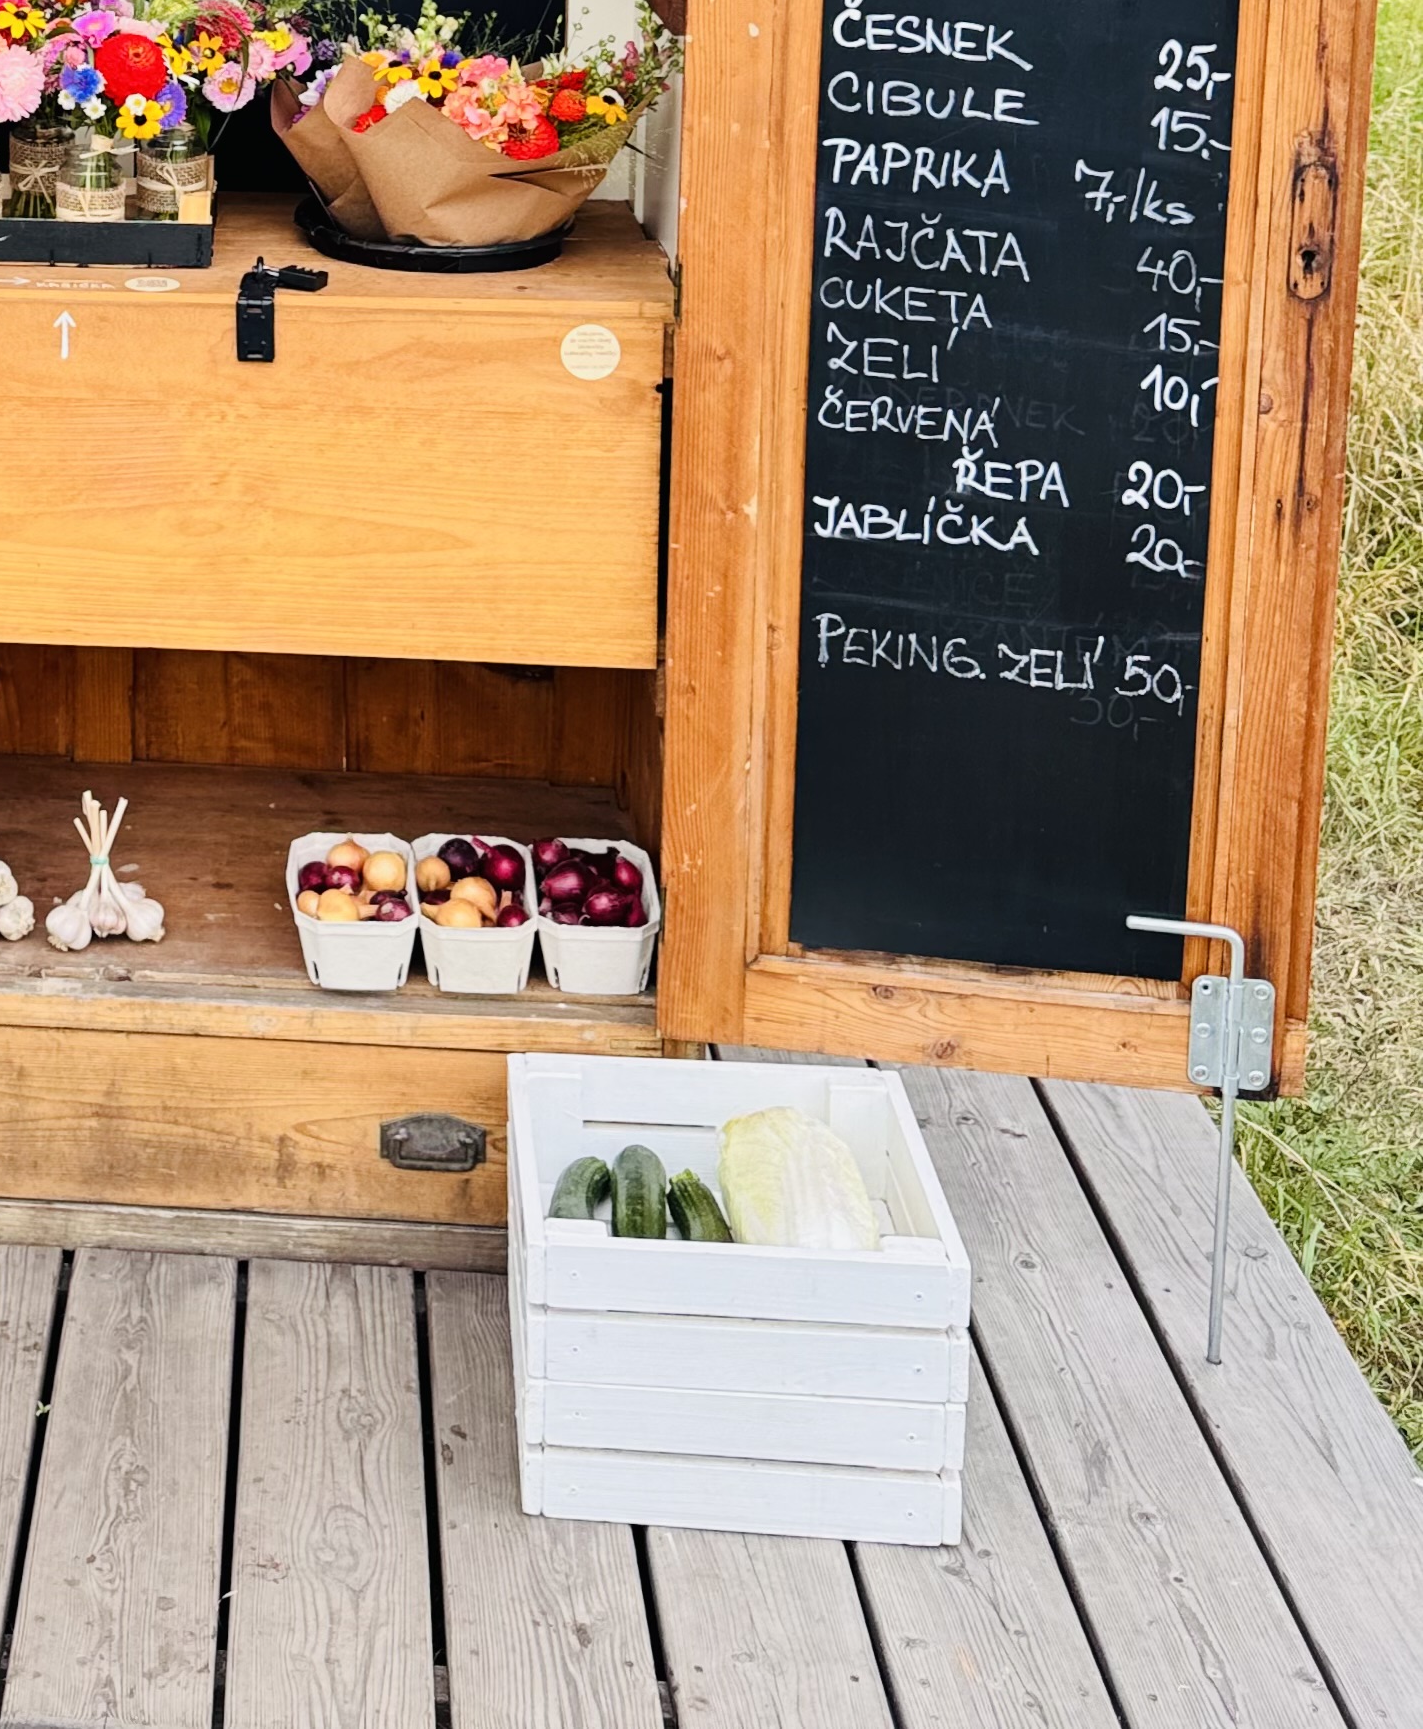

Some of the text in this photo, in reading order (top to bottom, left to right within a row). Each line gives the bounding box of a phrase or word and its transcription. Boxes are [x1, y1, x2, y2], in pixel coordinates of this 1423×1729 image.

[828, 71, 1039, 125] CIBULE
[823, 138, 1009, 197] PAPRIKA
[824, 207, 1029, 282] RAJČATA
[820, 277, 992, 330] CUKETA
[827, 322, 958, 383] ZELÍ
[818, 385, 1000, 448] ČERVENÁ
[952, 446, 1069, 507] ŘEPA
[813, 496, 1039, 555] JABLÍČKA
[998, 636, 1104, 690] ZELÍ
